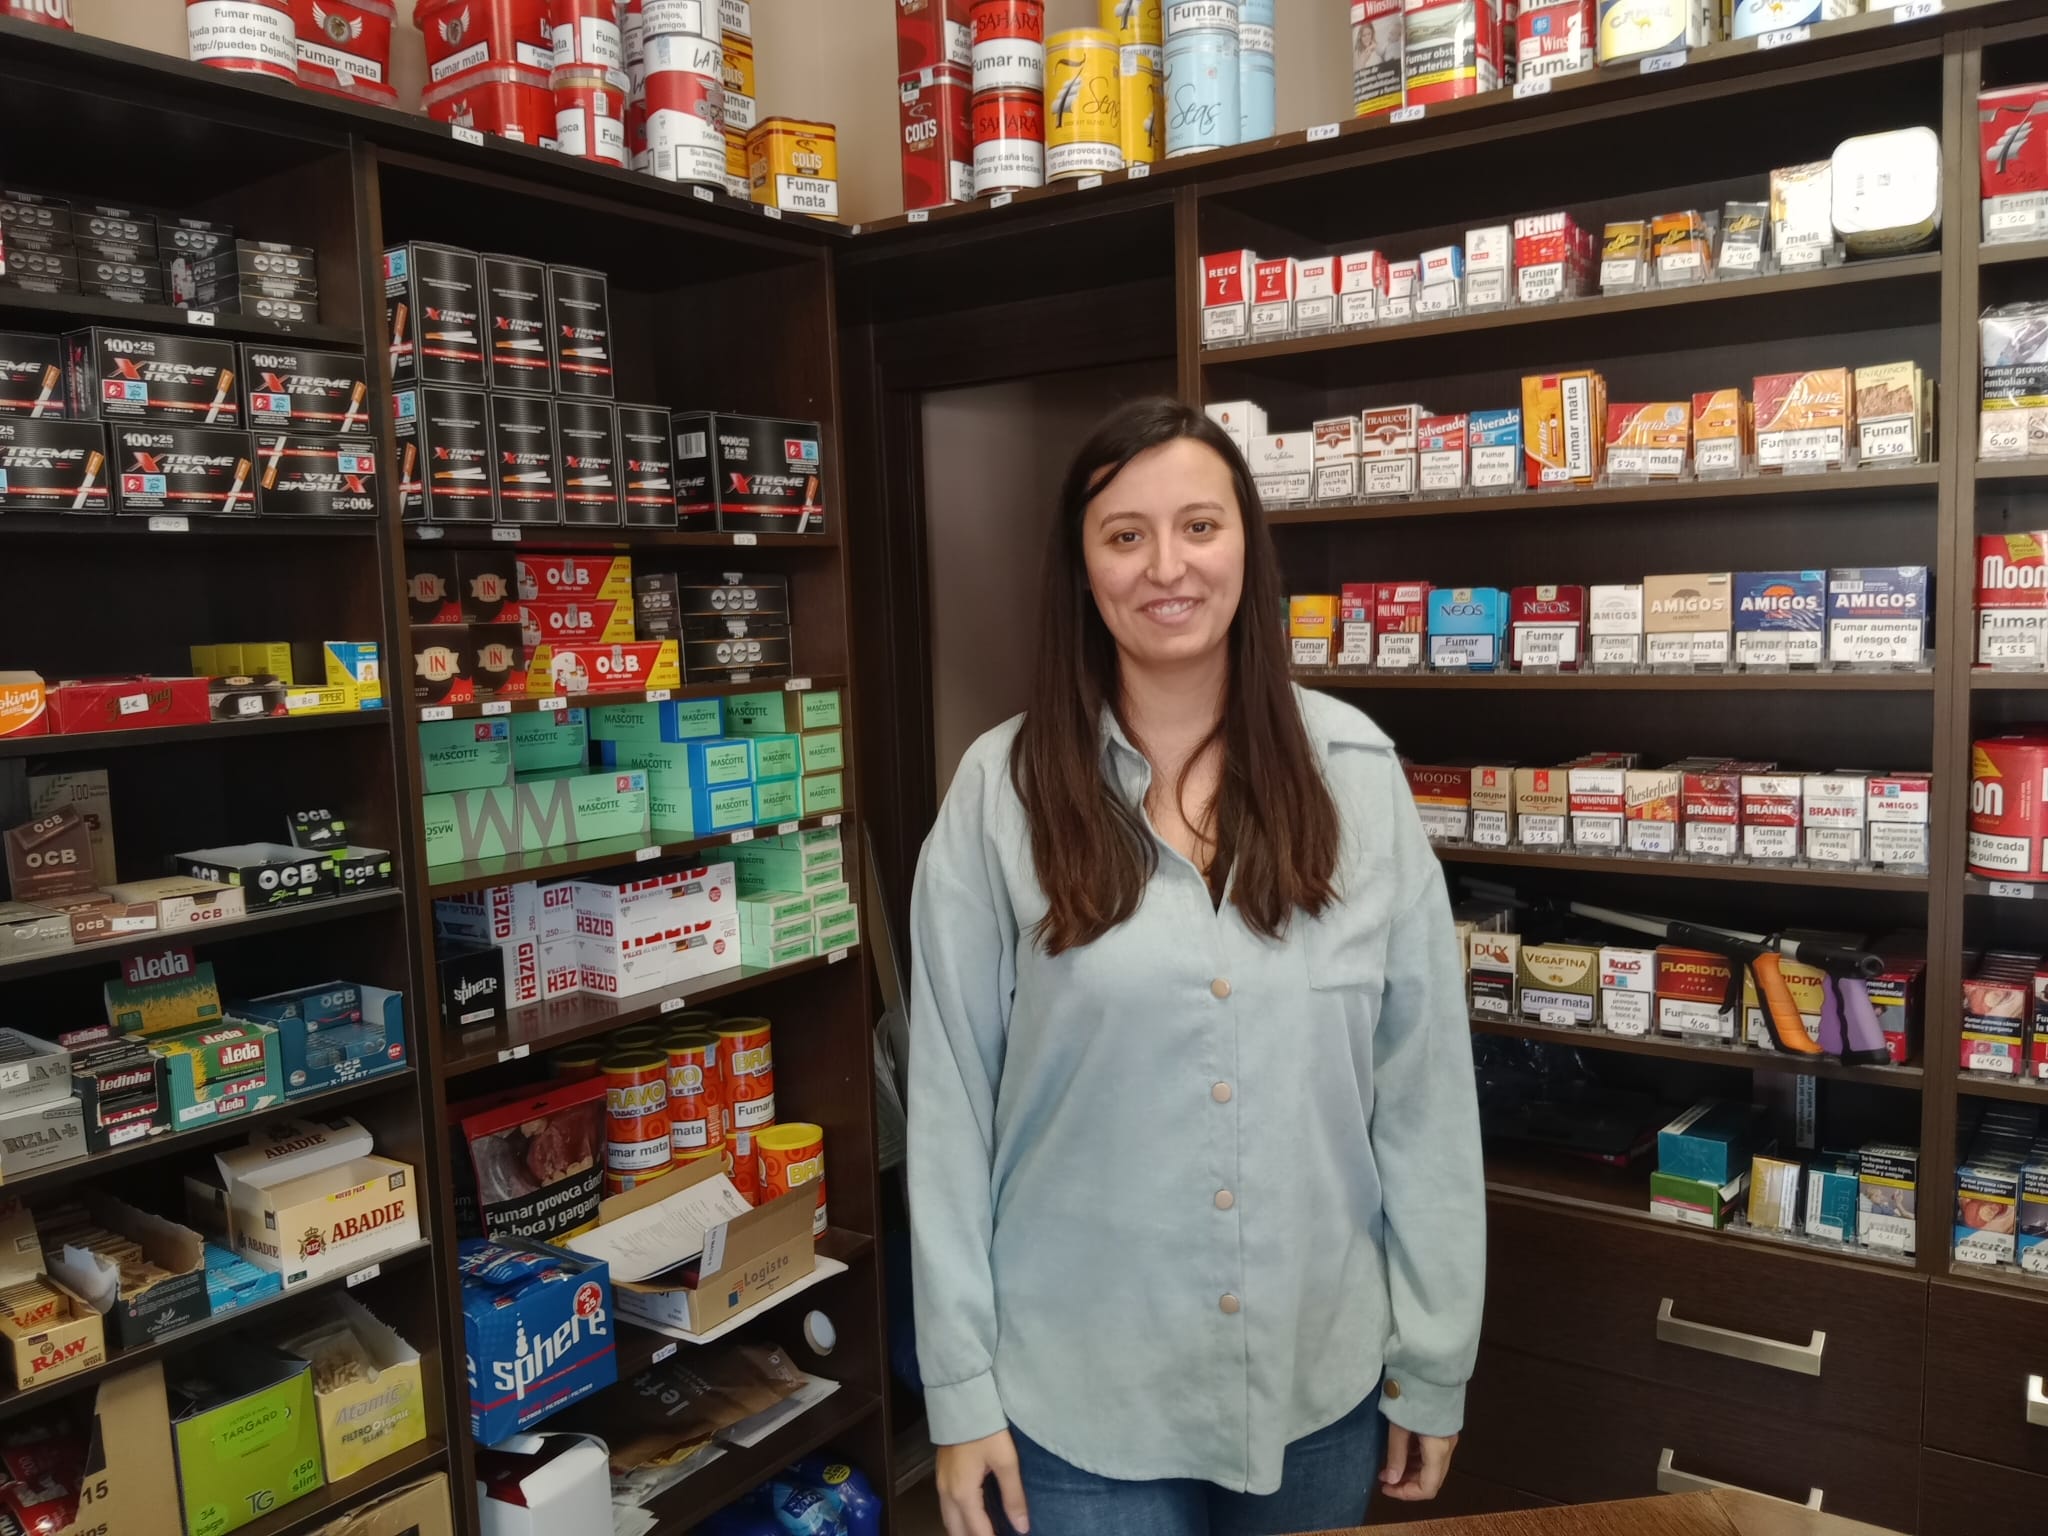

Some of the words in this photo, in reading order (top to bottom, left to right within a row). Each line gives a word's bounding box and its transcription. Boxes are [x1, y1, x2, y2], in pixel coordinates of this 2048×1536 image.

[661, 10, 683, 21] hijos,
[1172, 2, 1221, 21] Fumar
[252, 13, 279, 26] mata
[657, 22, 687, 31] amigos
[211, 24, 237, 36] para
[239, 23, 267, 39] dejar
[296, 43, 340, 67] Fumar
[344, 60, 378, 79] mata
[461, 48, 487, 67] mata
[1521, 53, 1590, 80] Fumar
[905, 119, 937, 144] COLTS
[1022, 152, 1034, 163] los
[1067, 146, 1102, 158] provoca
[791, 151, 823, 170] COLTS
[1000, 162, 1014, 172] las
[785, 178, 831, 196] Fumar
[791, 193, 827, 209] mata
[1514, 212, 1566, 239] DENIM
[253, 253, 301, 276] OCB
[1209, 265, 1238, 278] REIG
[1258, 265, 1282, 276] REIG
[1347, 262, 1367, 272] REIG
[1304, 268, 1324, 277] REIG
[1393, 268, 1413, 278] REIG
[1522, 267, 1559, 279] Fumar
[1217, 279, 1228, 295] 7
[1266, 275, 1274, 288] 7
[255, 300, 304, 321] OCB
[1984, 375, 2027, 388] embolias
[2028, 376, 2035, 385] e
[1984, 387, 2026, 399] invalidez
[1569, 385, 1580, 422] mata
[1367, 413, 1410, 426] TRABUCOS
[1469, 410, 1519, 433] Silverado
[1316, 423, 1350, 434] TRABUCOS
[1418, 415, 1466, 439] Silverado
[1863, 422, 1910, 439] Fumar
[1569, 425, 1582, 470] Fumar
[1989, 434, 2018, 447] 6,00
[1650, 453, 1680, 468] mata
[1791, 448, 1817, 460] 5'55
[1319, 468, 1350, 480] Fumar
[1370, 463, 1405, 474] Fumar
[1982, 555, 2048, 590] Moon
[420, 578, 436, 596] IN
[711, 589, 759, 611] OCB
[1650, 598, 1724, 614] AMIGOS
[1740, 594, 1818, 612] AMIGOS
[1835, 592, 1917, 608] AMIGOS
[1377, 605, 1390, 617] PALL
[1391, 604, 1405, 616] MALL
[1441, 603, 1483, 616] NEOS
[1523, 601, 1570, 615] NEOS
[1593, 610, 1638, 621] AMIGOS
[1833, 622, 1868, 633] Fumar
[1870, 622, 1918, 633] aumenta
[1294, 640, 1326, 650] Fumar
[1384, 635, 1415, 645] Fumar
[1445, 636, 1479, 647] Fumar
[1693, 638, 1725, 650] mata
[1739, 638, 1781, 651] Fumar
[1785, 638, 1819, 650] mata
[1843, 634, 1853, 645] el
[1855, 634, 1888, 647] riesgo
[1890, 634, 1908, 645] de
[487, 649, 504, 666] IN
[716, 641, 764, 665] OCB
[1387, 646, 1411, 655] mata
[1997, 645, 2027, 656] 1'55
[429, 654, 448, 674] IN
[450, 693, 472, 702] 500
[727, 707, 768, 717] MASCOTTE
[806, 704, 836, 713] MASCOTTE
[604, 713, 645, 724] MASCOTTE
[682, 712, 717, 722] MASCOTTE
[516, 733, 558, 744] MASCOTTE
[429, 748, 479, 762] MASCOTTE
[809, 746, 836, 755] MASCOTTE
[631, 758, 672, 770] MASCOTTE
[710, 756, 745, 767] MASCOTTE
[1413, 772, 1461, 785] MOODS
[70, 783, 89, 801] 100
[762, 793, 792, 804] MASCOTTE
[810, 787, 837, 797] MASCOTTE
[1472, 791, 1506, 800] COBURN
[1626, 778, 1679, 808] Chesterfield
[578, 801, 620, 812] MASCOTTE
[715, 799, 749, 811] MASCOTTE
[1519, 795, 1563, 804] COBURN
[1571, 795, 1619, 806] NEWMINSTER
[1878, 801, 1919, 810] AMIGOS
[297, 808, 332, 823] OCB
[1686, 803, 1736, 816] BRANIFF
[1745, 803, 1795, 816] BRANIFF
[1808, 806, 1858, 818] BRANIFF
[33, 814, 64, 834] OCB
[1475, 813, 1504, 823] Fumar
[1752, 827, 1787, 839] Fumar
[1815, 830, 1850, 841] Fumar
[1982, 839, 1994, 849] de
[1996, 840, 2025, 852] cada
[25, 848, 77, 869] OCB
[1978, 851, 2018, 865] pulmón
[258, 862, 320, 891] OCB
[344, 864, 376, 880] OCB
[189, 907, 223, 922] OCB
[75, 918, 105, 932] OCB
[576, 914, 614, 937] GIZEH
[1474, 943, 1508, 963] DUX
[1525, 951, 1587, 970] VEGAFINA
[518, 941, 538, 1001] GIZEH
[1661, 961, 1732, 979] FLORIDITA
[580, 971, 617, 994] GIZEH
[453, 976, 498, 1006] sphere
[1522, 992, 1560, 1007] Fumar
[1561, 996, 1591, 1010] mata
[672, 1124, 703, 1137] mata
[264, 1133, 327, 1159] ABADIE
[639, 1140, 668, 1155] mata
[485, 1200, 533, 1226] Fumar
[535, 1185, 582, 1216] provoca
[331, 1200, 405, 1244] ABADIE
[547, 1214, 558, 1233] y
[247, 1236, 279, 1258] ABADIE
[31, 1336, 88, 1373] RAW
[492, 1307, 608, 1401] sphere
[222, 1409, 278, 1444] TARGARD
[341, 1424, 372, 1444] FILTRO
[292, 1460, 314, 1479] 150
[291, 1472, 318, 1492] slim
[82, 1480, 109, 1503] 15
[245, 1489, 275, 1515] TG
